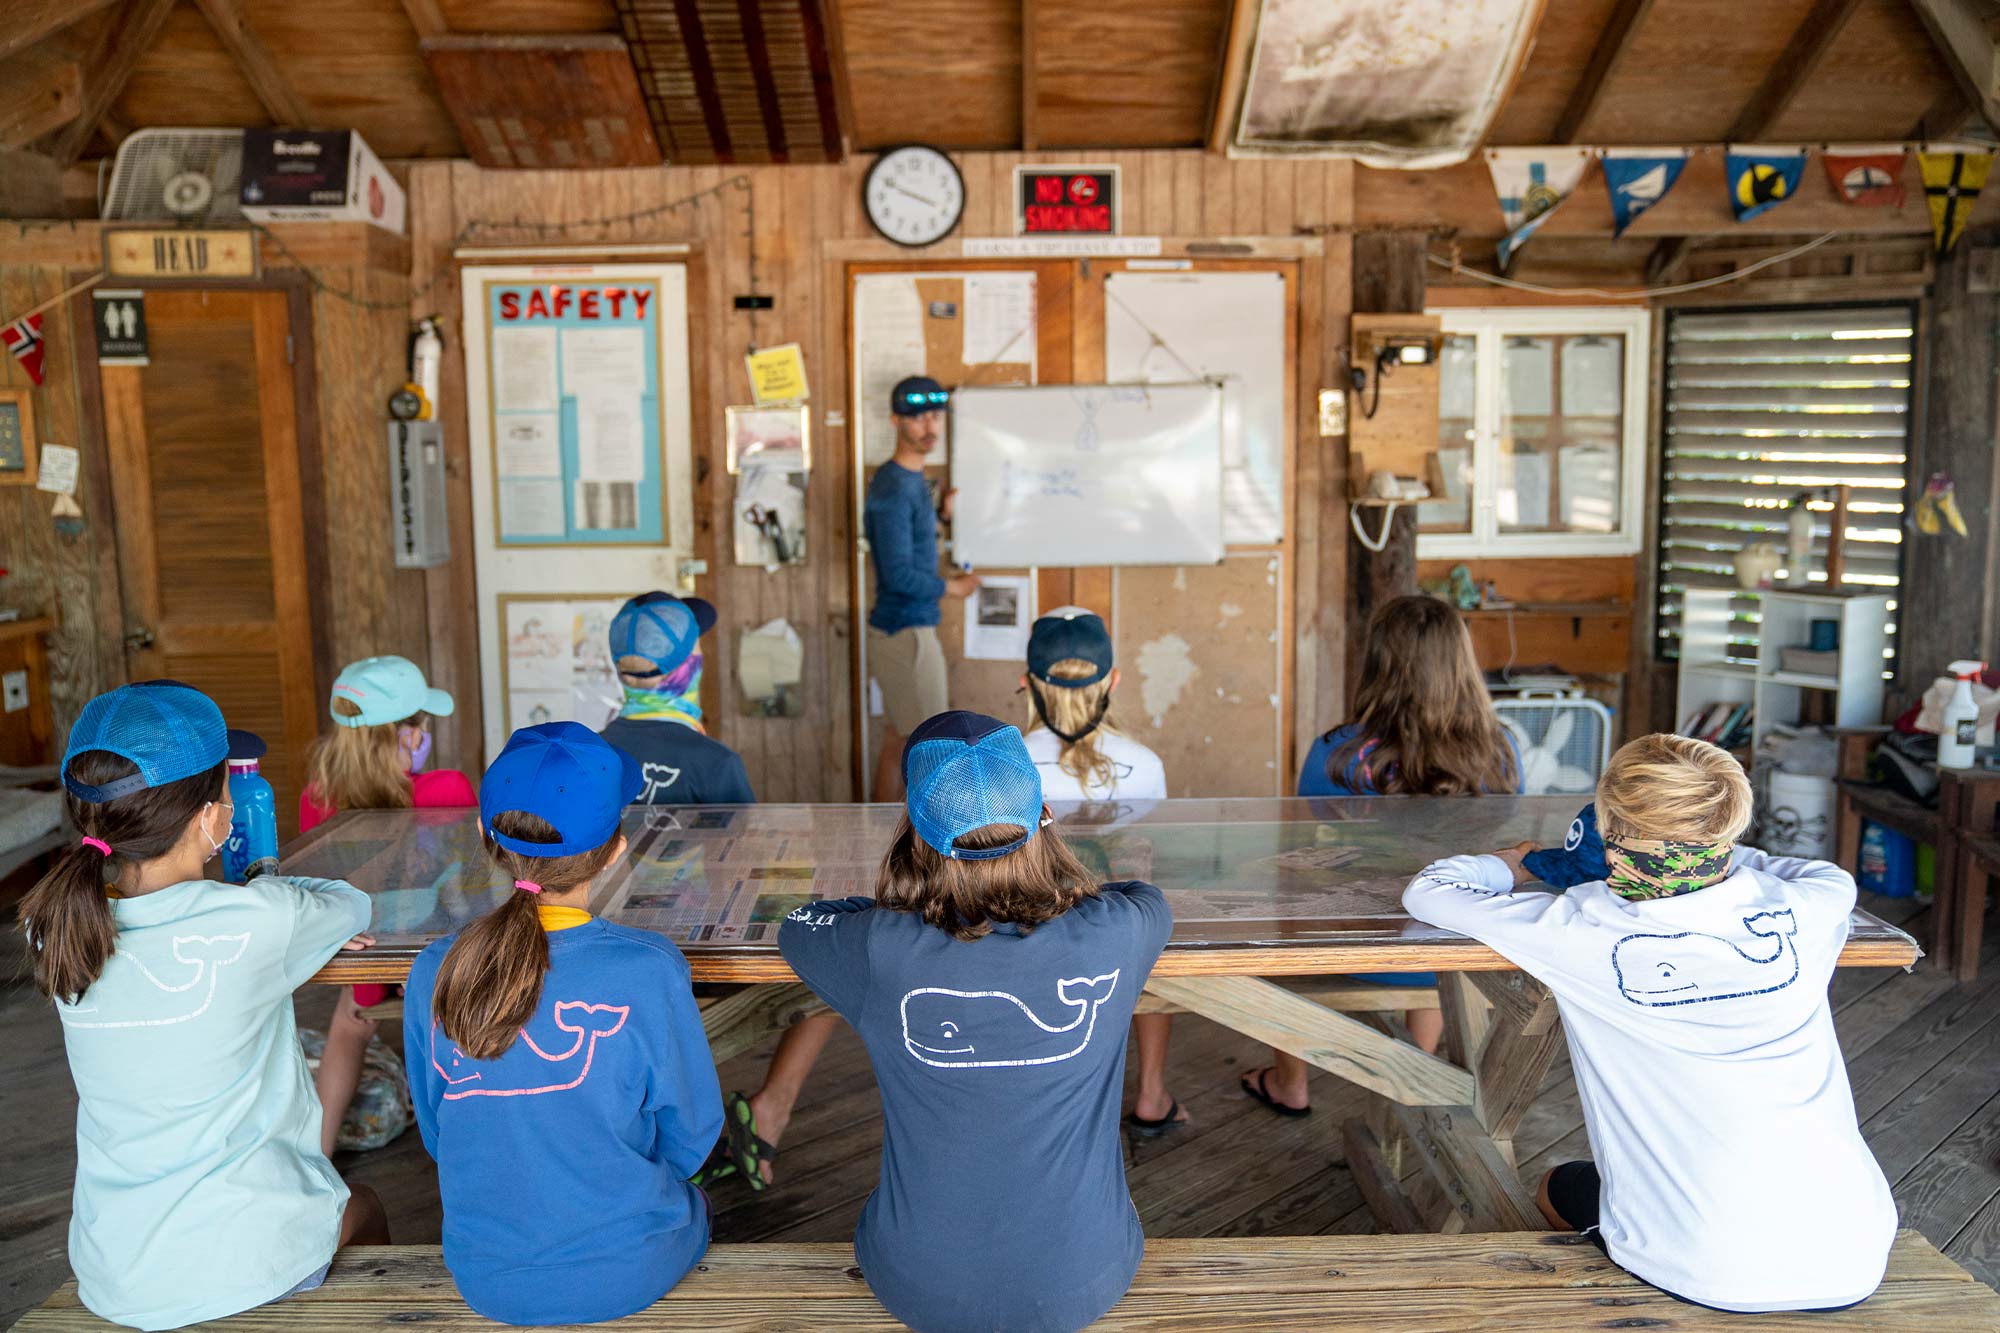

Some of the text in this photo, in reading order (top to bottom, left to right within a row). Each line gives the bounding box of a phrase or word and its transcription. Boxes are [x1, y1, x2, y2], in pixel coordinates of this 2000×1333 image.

[1035, 175, 1064, 203] NO
[1025, 205, 1110, 232] SMOKING
[153, 237, 208, 271] HEAD
[499, 285, 652, 320] SAFETY
